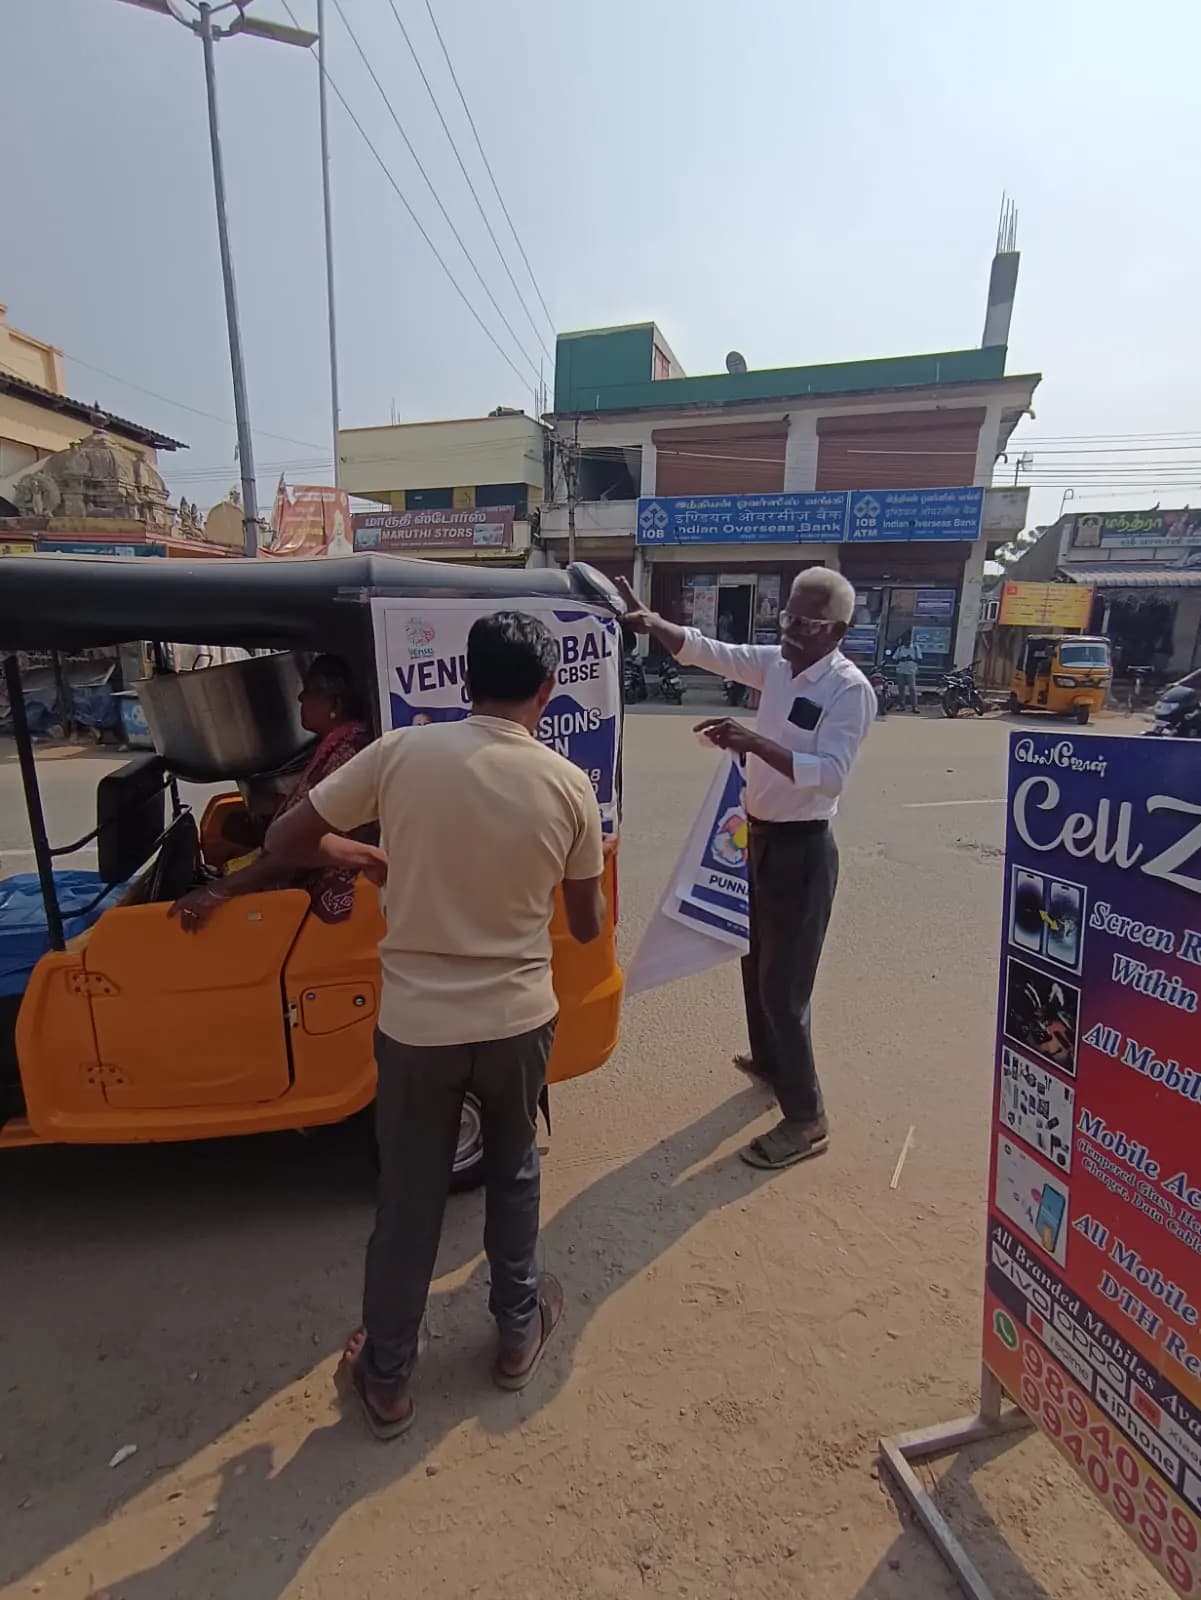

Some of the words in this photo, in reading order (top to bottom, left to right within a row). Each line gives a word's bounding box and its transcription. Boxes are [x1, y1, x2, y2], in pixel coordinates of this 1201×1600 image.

[365, 513, 412, 528] மாருதி
[382, 528, 431, 540] MARUTHI
[435, 527, 473, 538] STORS
[642, 529, 665, 539] IOB
[723, 523, 795, 534] Overseas
[799, 522, 841, 533] Bank
[853, 528, 878, 537] ATM
[856, 518, 877, 527] IOB
[883, 519, 910, 529] Indian
[954, 518, 977, 527] Bank
[558, 662, 600, 686] CBSE
[533, 708, 601, 739] SIONS
[709, 874, 748, 896] PUNN
[1089, 901, 1175, 954] Screen
[1112, 952, 1198, 1013] Within
[1082, 1022, 1122, 1058] All
[1121, 1038, 1201, 1105] Mobil
[1076, 1107, 1161, 1180] Mobile
[1131, 1192, 1164, 1224] Data
[994, 1248, 1050, 1313] vivo
[1072, 1213, 1110, 1251] All
[1108, 1235, 1199, 1326] Mobile
[992, 1227, 1012, 1250] All
[1015, 1245, 1080, 1317] Branded
[1083, 1311, 1156, 1391] Mobiles
[1097, 1269, 1163, 1340] DTH
[1162, 1326, 1201, 1382] Re
[1057, 1310, 1125, 1383] oppo
[1111, 1396, 1175, 1477] iPhone
